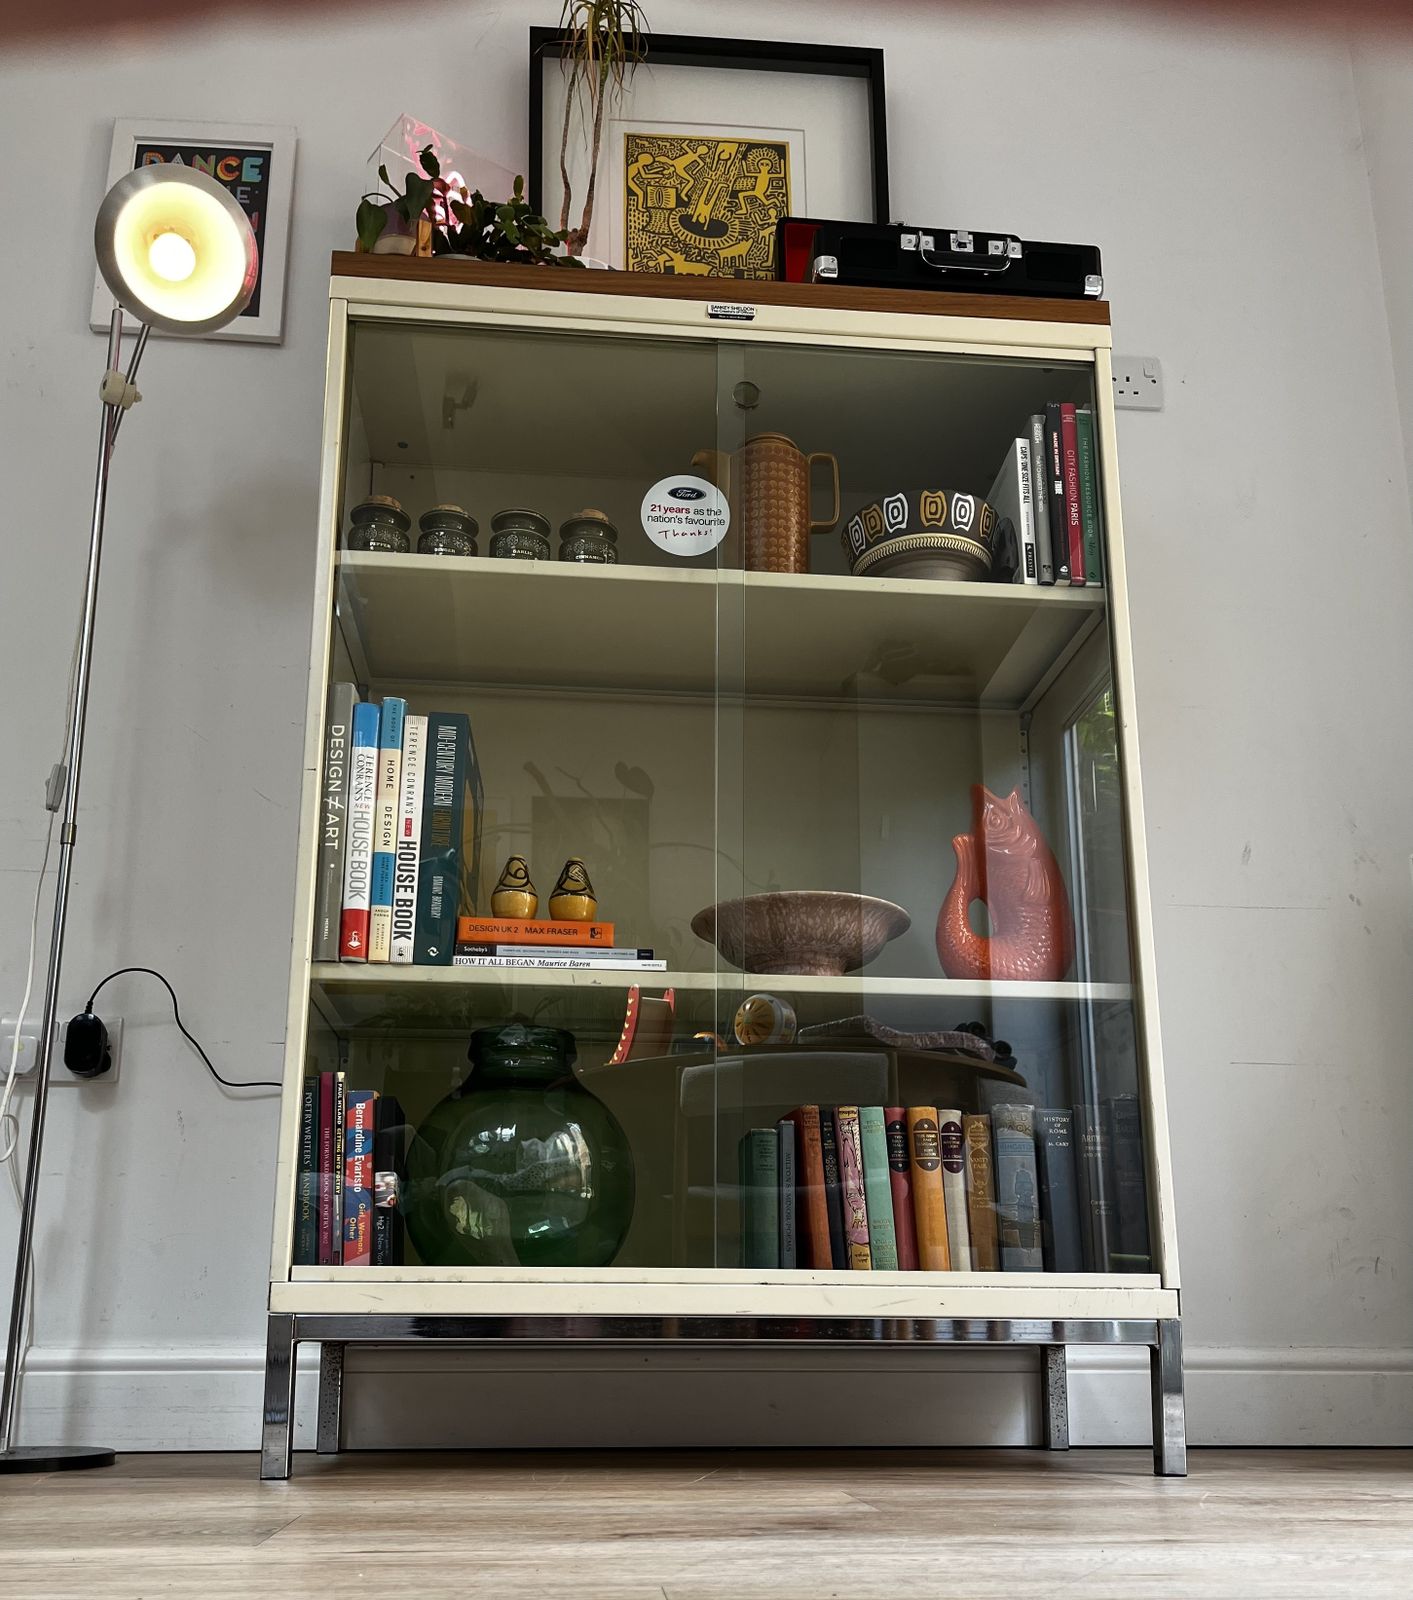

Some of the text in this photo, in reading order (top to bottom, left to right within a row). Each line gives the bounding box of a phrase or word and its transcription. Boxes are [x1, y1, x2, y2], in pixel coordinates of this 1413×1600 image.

[675, 489, 698, 498] Ford
[1022, 483, 1030, 495] FITS
[1066, 450, 1079, 526] CITY FASHION PARIS
[647, 514, 726, 526] nation's favourite
[650, 504, 661, 512] 21
[663, 506, 690, 515] years
[706, 508, 722, 516] the
[658, 529, 713, 539] Thanks!
[327, 725, 345, 792] DESIGN
[435, 725, 457, 774] MID-CENTURY
[354, 754, 364, 802] CONRAN'S
[363, 755, 374, 801] TERENCE
[405, 726, 418, 814] TERENCE CONRAN'S
[383, 760, 395, 847] HOME DESIGN
[433, 775, 454, 806] MODERN
[325, 813, 339, 850] ART
[348, 810, 371, 901] HOUSE BOOK
[393, 840, 417, 941] HOUSE BOOK
[464, 945, 488, 953] Sotheby's
[469, 924, 578, 936] DESIGN UK 2 MAX FRASER
[455, 957, 591, 968] HOW IT ALL BEGAN Maurice Baren
[305, 1092, 313, 1124] POETRY
[304, 1125, 312, 1167] WRITERS'
[354, 1103, 366, 1193] Bernardine Evaristo
[302, 1169, 310, 1221] HANDBOOK
[349, 1217, 357, 1240] Other
[357, 1203, 366, 1255] Girl, Woman,
[377, 1216, 385, 1230] Hg2
